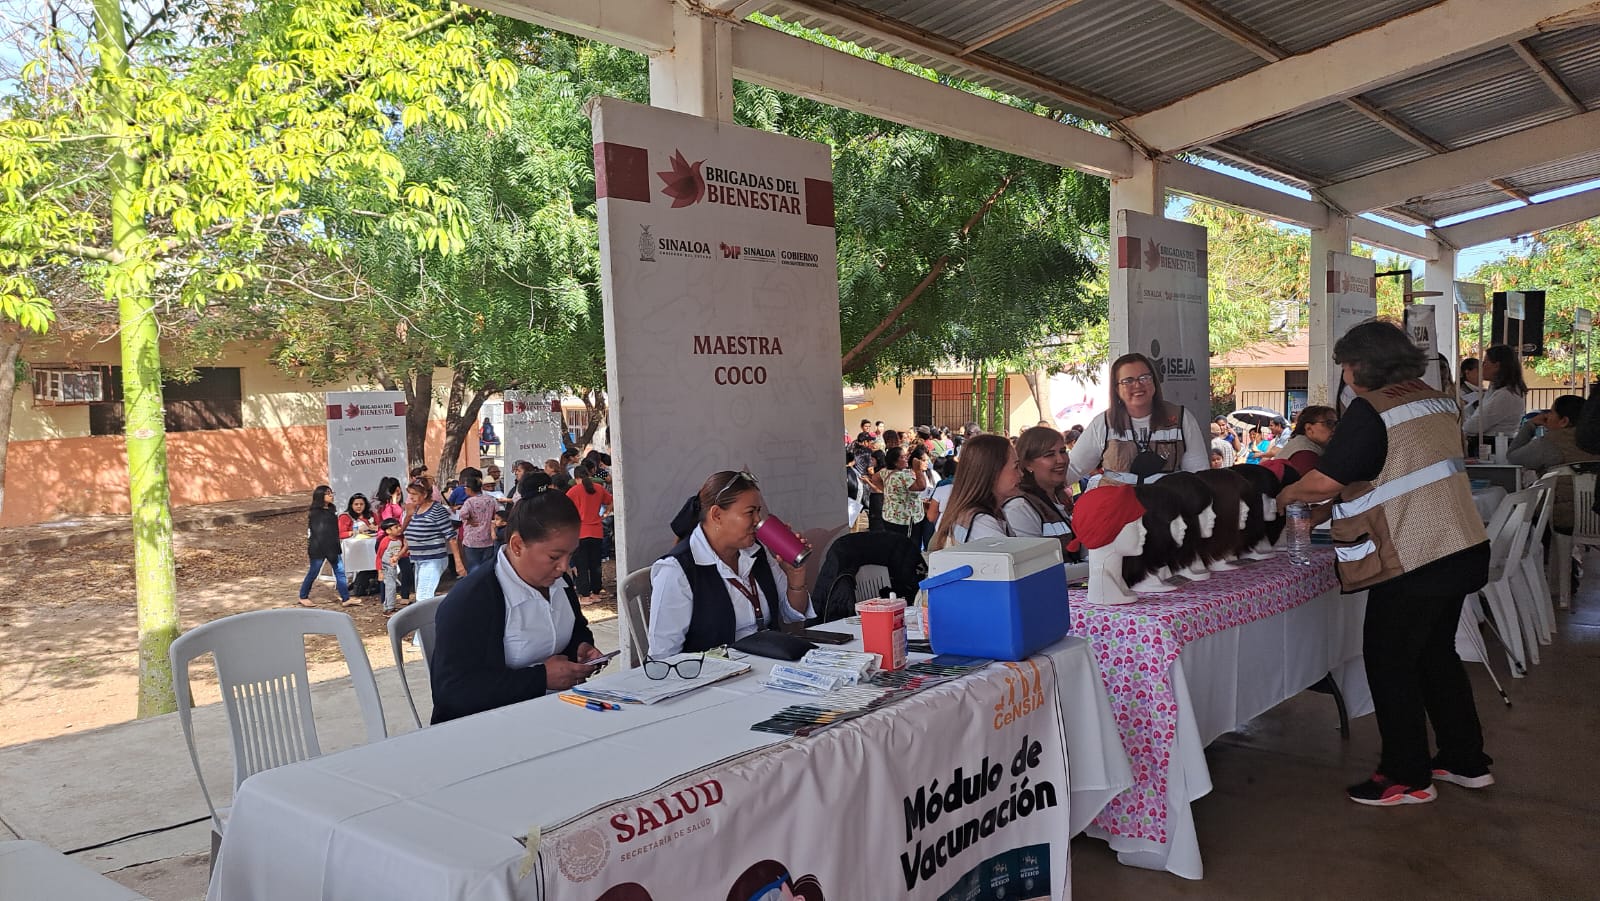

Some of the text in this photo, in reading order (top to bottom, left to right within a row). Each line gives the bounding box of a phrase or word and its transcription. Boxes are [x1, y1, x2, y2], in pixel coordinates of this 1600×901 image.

[706, 167, 800, 195] BRIGADAS DEL
[707, 184, 801, 215] BIENESTAR
[658, 238, 711, 255] SINALOA
[723, 243, 741, 260] DIF
[743, 247, 776, 258] SINALOA
[781, 250, 819, 262] GOBIERNO
[1160, 256, 1197, 273] BIENESTAR
[693, 336, 783, 355] MAESTRA
[1167, 357, 1196, 374] ISEJA
[714, 366, 767, 385] COCO
[350, 456, 397, 467] COMUNITARIO
[352, 448, 394, 457] DESARROLLO
[993, 693, 1045, 730] CeNSIA
[904, 734, 1043, 843] Módulo de
[610, 779, 724, 843] SALUD
[620, 818, 711, 862] SECRETARÍA DE SALUD
[900, 776, 1058, 891] Vacunación
